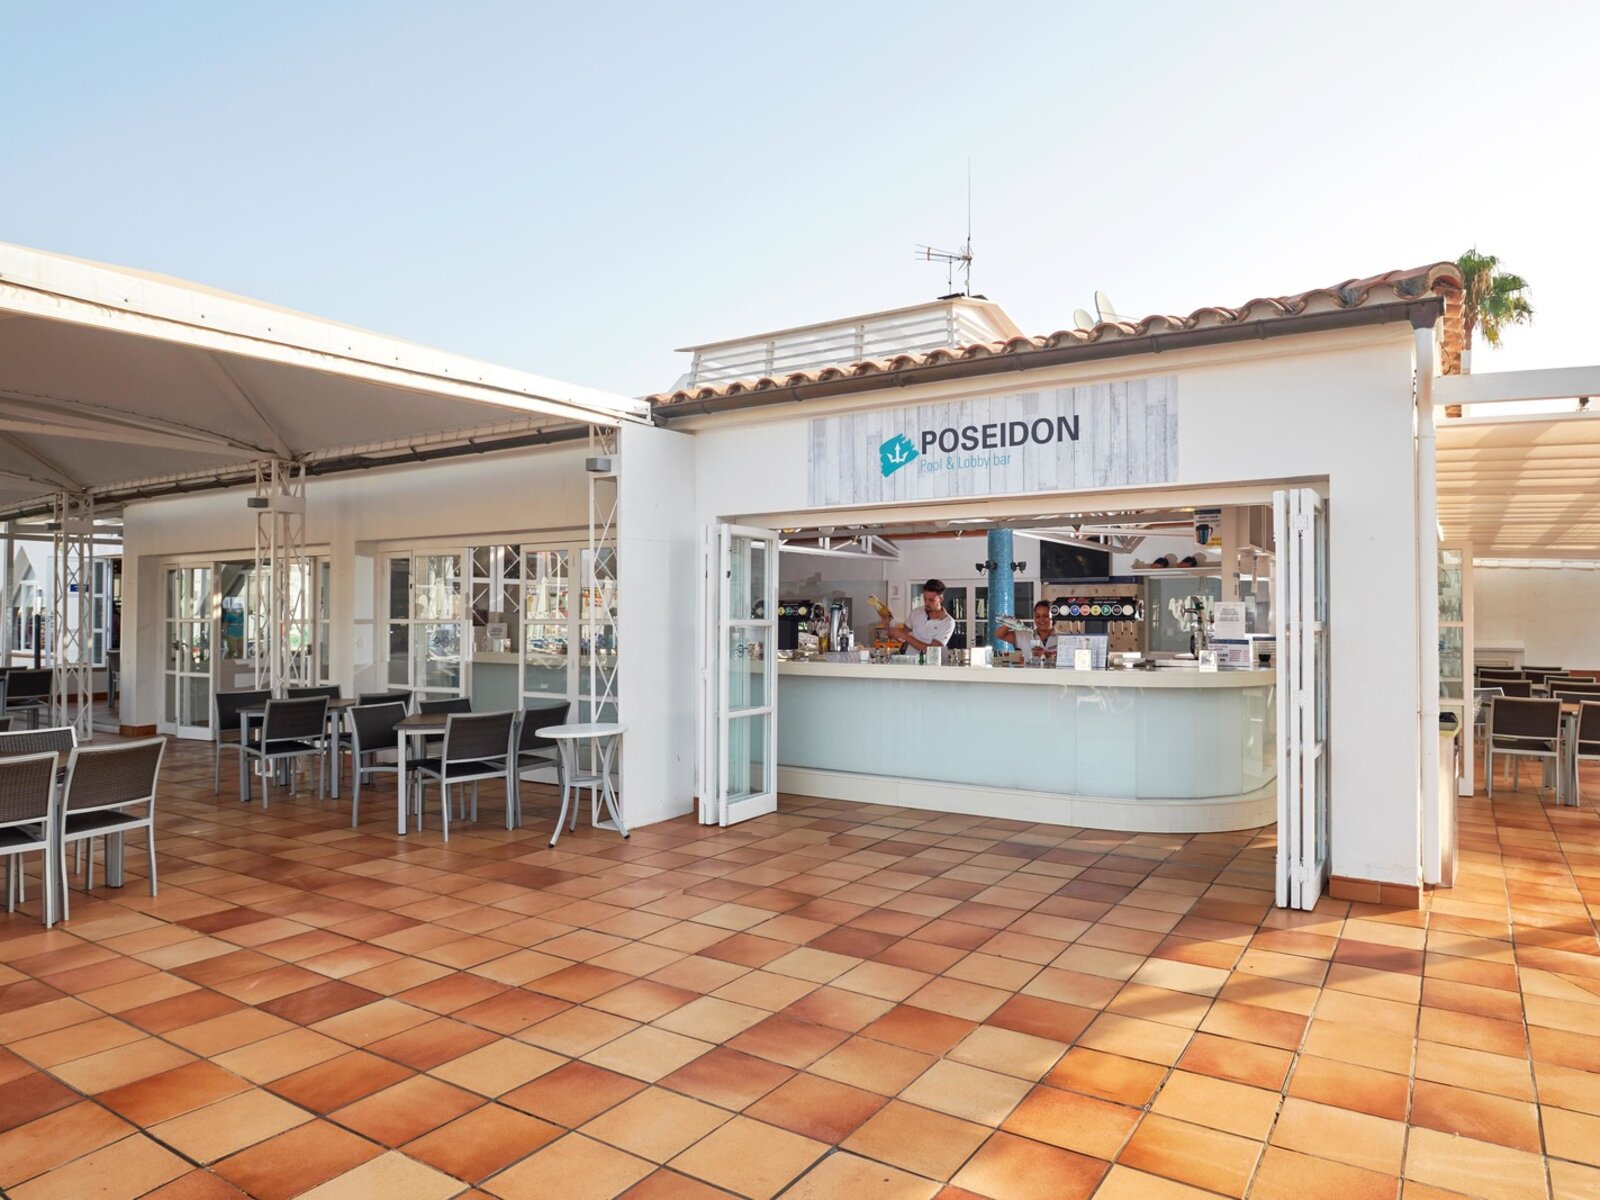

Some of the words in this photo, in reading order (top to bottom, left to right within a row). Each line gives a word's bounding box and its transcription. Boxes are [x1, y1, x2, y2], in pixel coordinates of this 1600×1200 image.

[921, 414, 1080, 455] POSEIDON
[920, 458, 942, 472] Pool
[946, 456, 955, 470] &
[957, 454, 991, 470] Lobby
[993, 453, 1012, 466] bar
